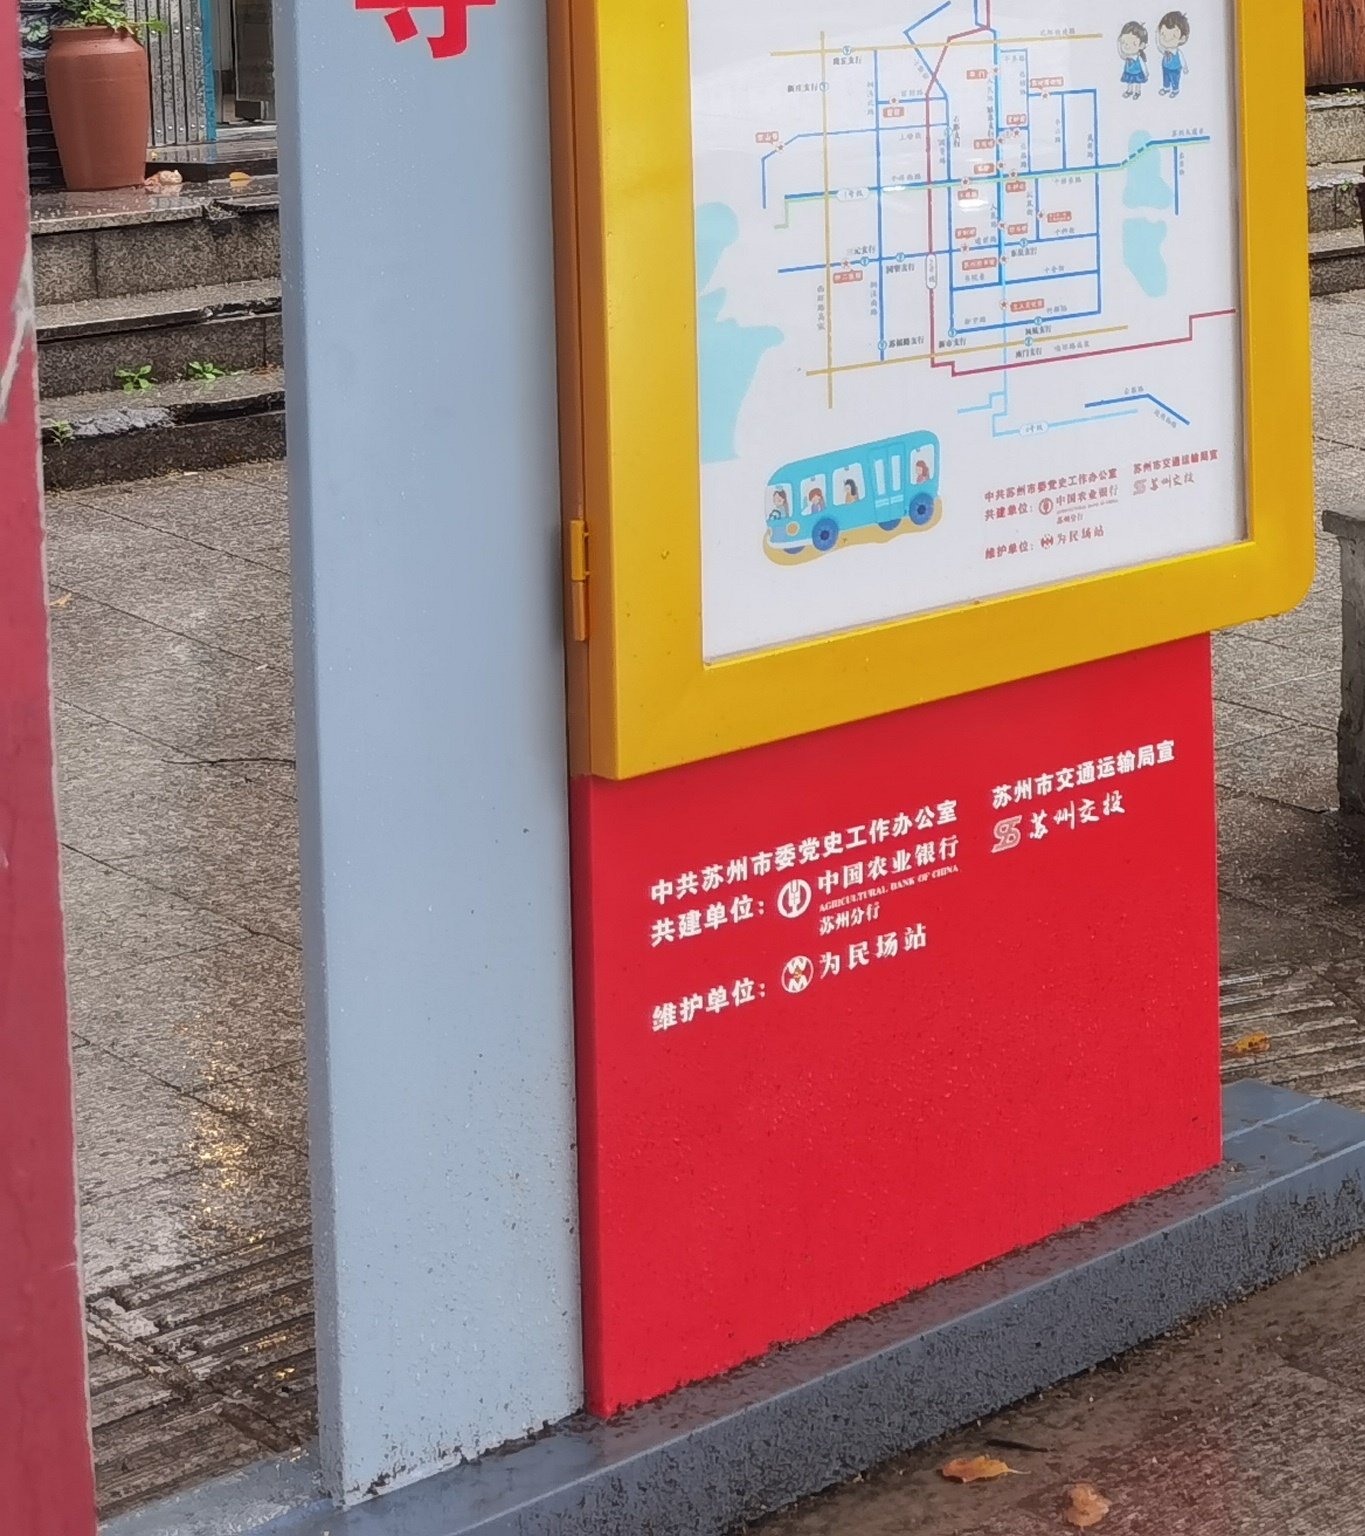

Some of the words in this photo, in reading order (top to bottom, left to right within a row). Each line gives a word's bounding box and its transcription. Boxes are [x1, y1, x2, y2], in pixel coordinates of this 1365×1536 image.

[1133, 449, 1218, 474] 苏州市交通运输局宣
[985, 468, 1117, 502] 中共苏州市委党史工作办公室
[1056, 485, 1118, 506] 中国农业银行
[1057, 525, 1104, 545] 为民场站
[991, 739, 1175, 809] 苏州市交通运输局宣
[651, 799, 958, 904] 中共苏州市委党史工作办公室
[651, 896, 766, 947] 共建单位：
[817, 835, 959, 895] 中国农业银行
[819, 883, 888, 912] AGRICULTURAL
[890, 876, 915, 893] BANK
[918, 871, 931, 885] OF
[932, 864, 959, 880] CHINA
[819, 902, 880, 935] 苏州分行
[652, 980, 766, 1032] 维护单位：
[820, 924, 927, 979] 为民场站
